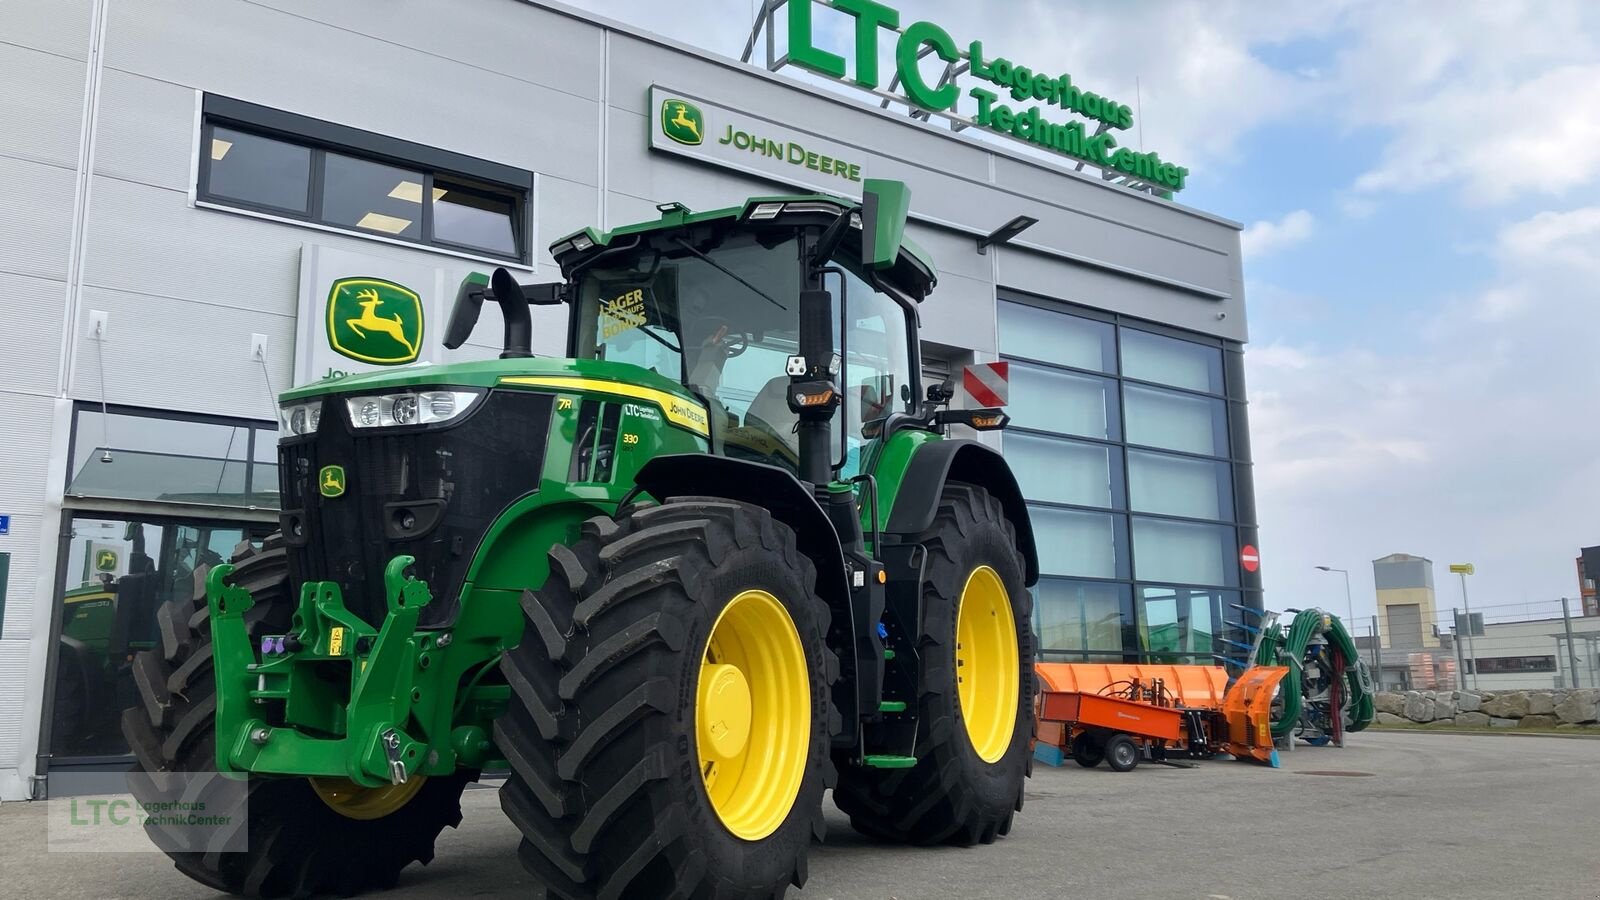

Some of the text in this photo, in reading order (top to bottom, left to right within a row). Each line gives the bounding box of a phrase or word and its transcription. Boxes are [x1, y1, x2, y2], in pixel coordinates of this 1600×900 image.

[788, 0, 960, 112] LTC
[969, 40, 1134, 130] Lagerhaus
[969, 87, 1190, 191] TechnikCenter
[718, 124, 861, 182] JOHN DEERE
[600, 288, 643, 315] LAGER
[322, 367, 360, 379] JO
[558, 398, 572, 410] 7R
[625, 403, 640, 417] LTC
[669, 401, 687, 417] JOHN
[686, 407, 705, 425] DEERE
[623, 433, 639, 444] 330
